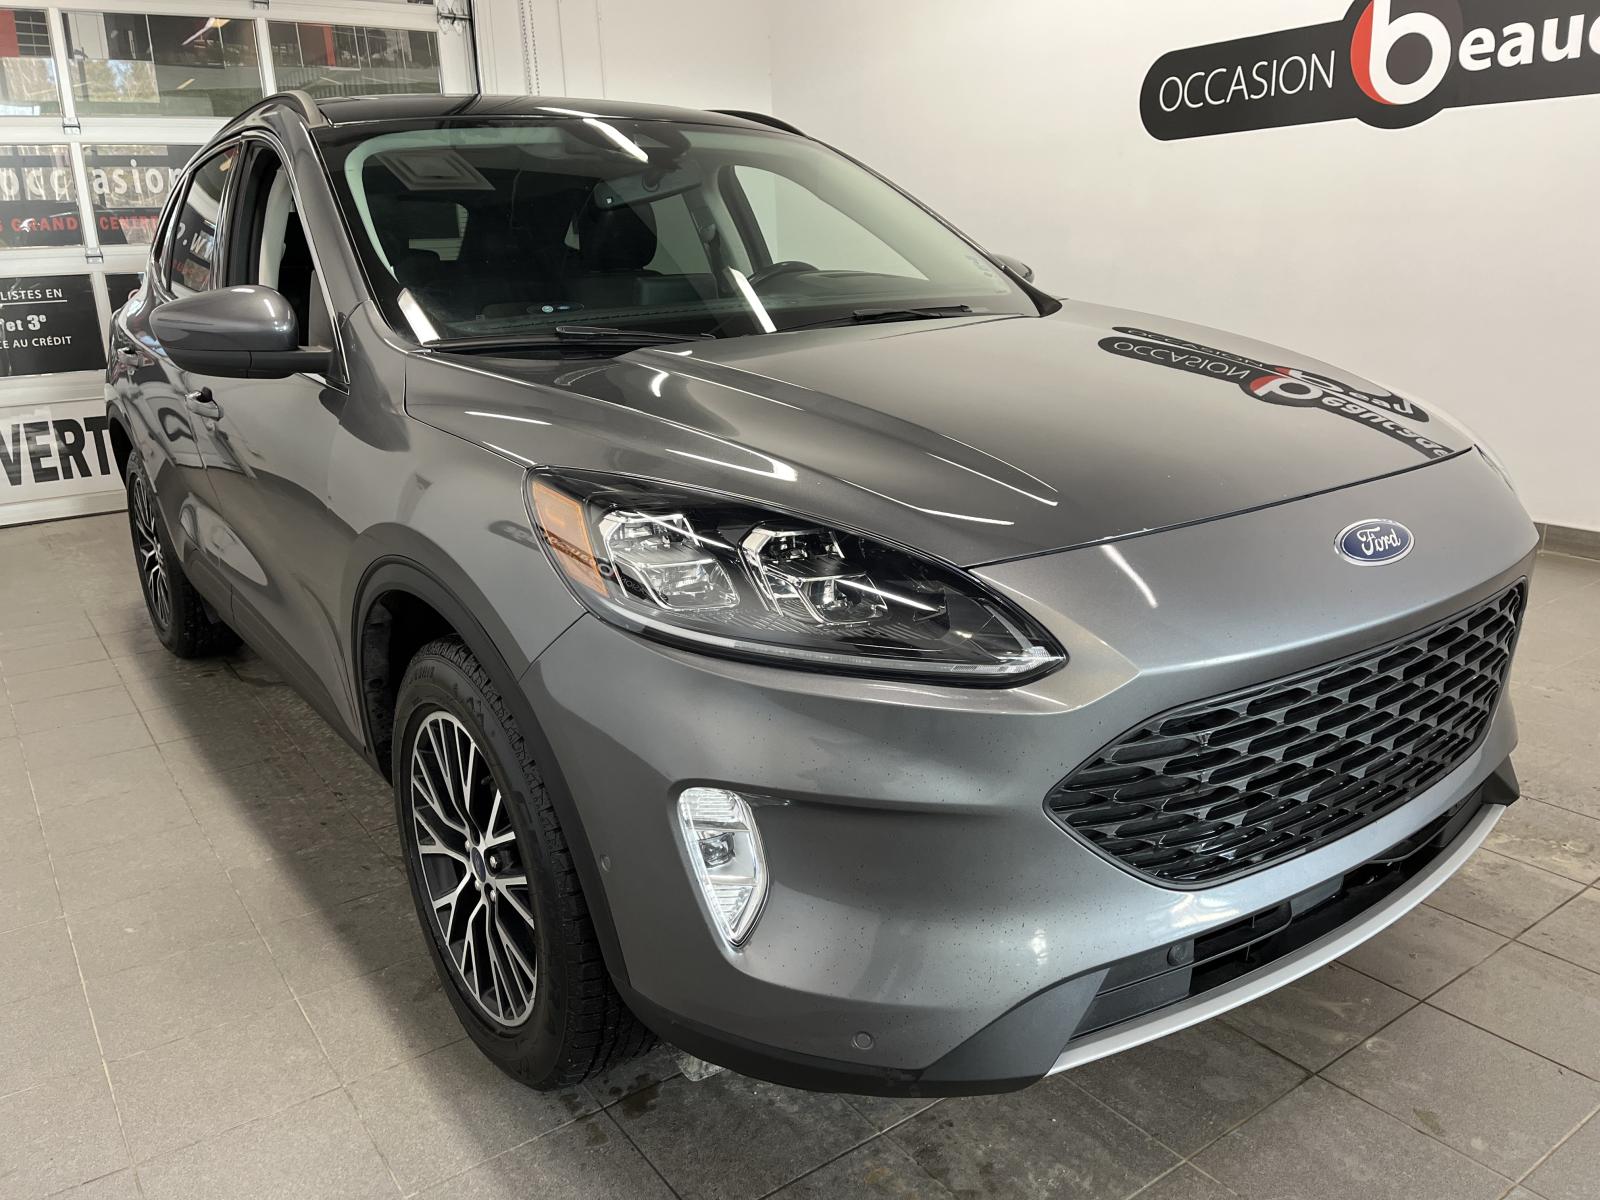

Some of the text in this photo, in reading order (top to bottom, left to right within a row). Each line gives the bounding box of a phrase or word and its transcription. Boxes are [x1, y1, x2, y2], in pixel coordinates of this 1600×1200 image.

[1158, 49, 1336, 112] OCCASION
[0, 288, 63, 301] LISTES EN
[5, 319, 24, 332] et
[13, 338, 28, 349] AU
[31, 335, 72, 347] CRÉDIT
[1356, 526, 1401, 556] Ford
